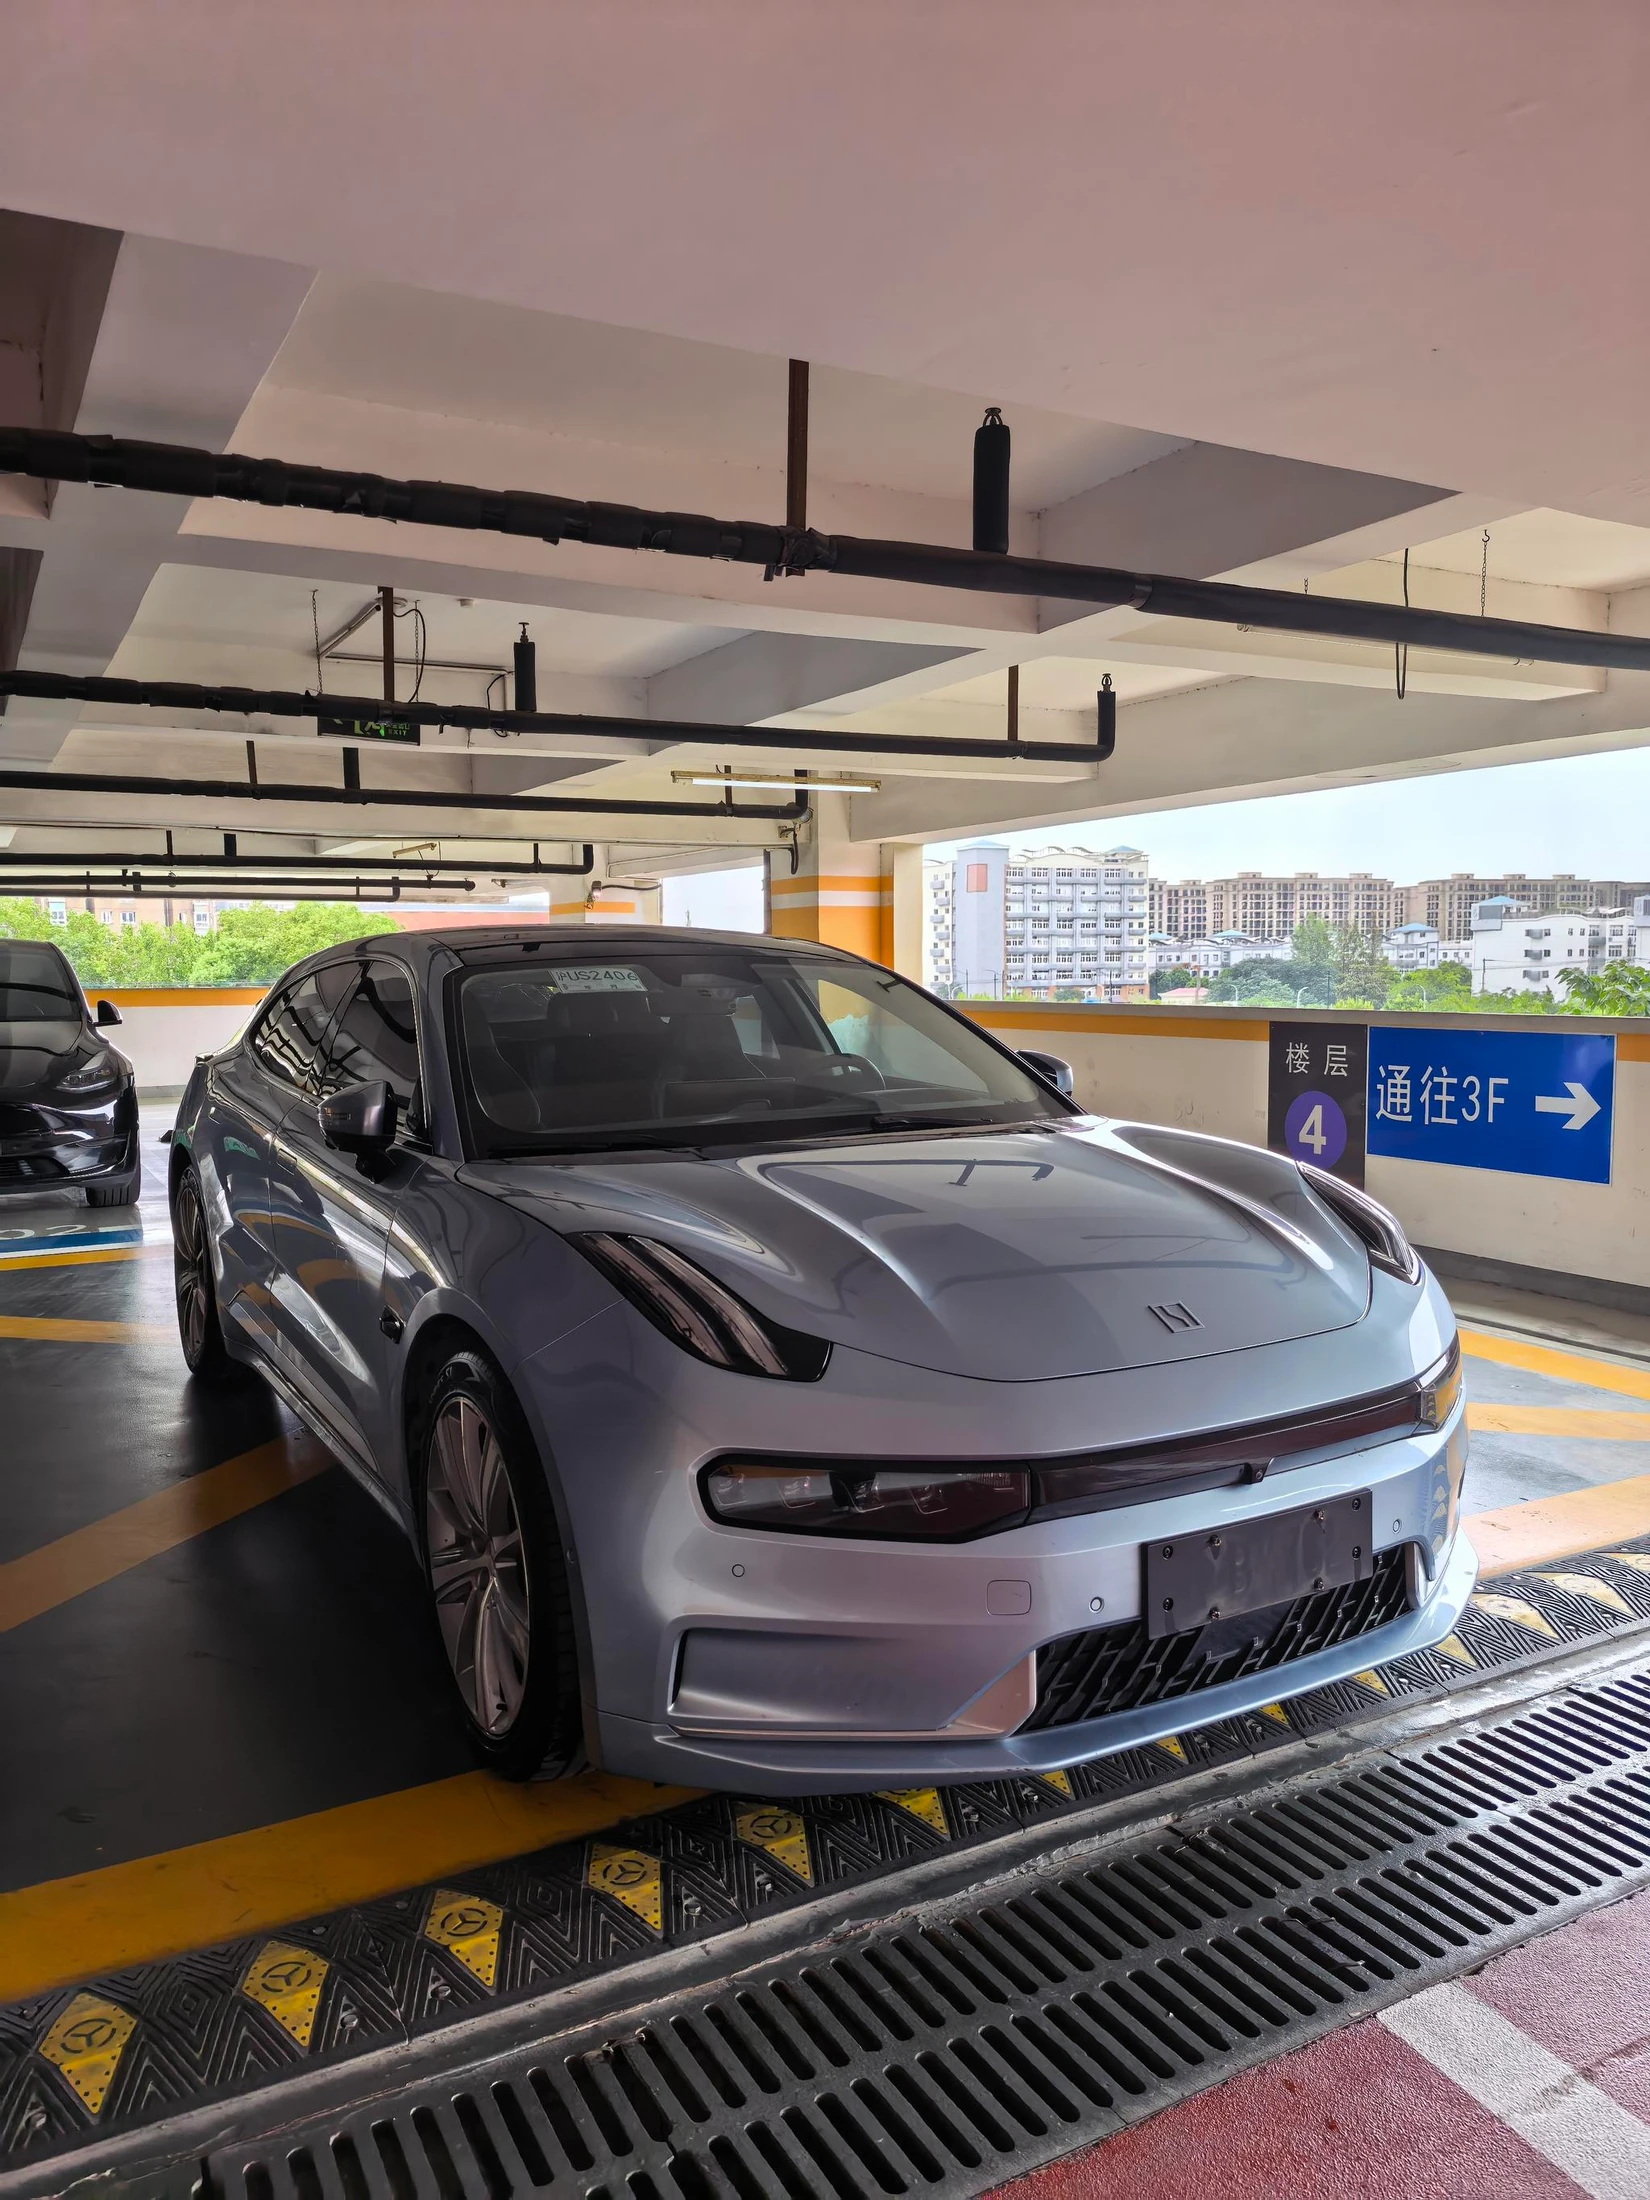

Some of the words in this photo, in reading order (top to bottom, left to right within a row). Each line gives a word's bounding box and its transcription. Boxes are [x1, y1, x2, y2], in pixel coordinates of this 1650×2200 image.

[1285, 1042, 1348, 1077] 楼层
[1375, 1065, 1509, 1125] 通往3F
[1298, 1104, 1327, 1155] 4
